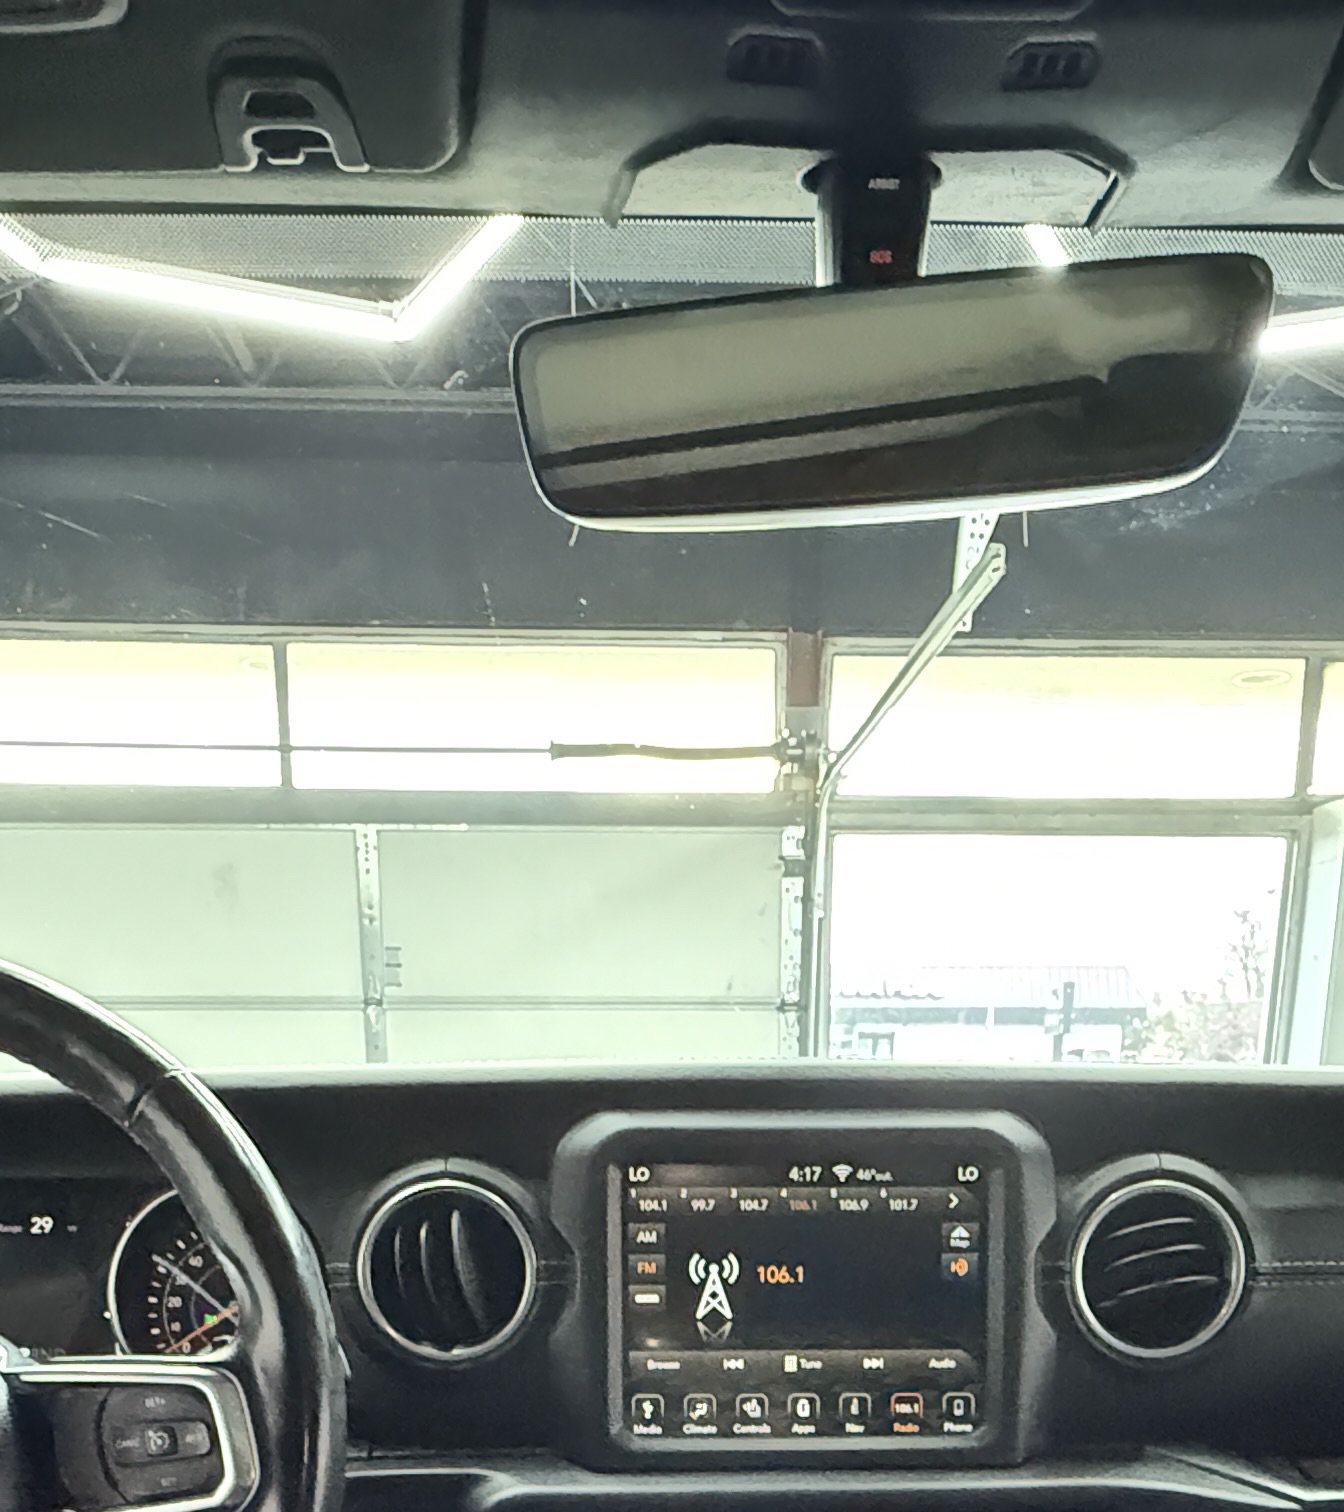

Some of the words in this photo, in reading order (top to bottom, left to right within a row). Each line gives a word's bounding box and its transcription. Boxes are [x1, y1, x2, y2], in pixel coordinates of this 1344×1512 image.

[869, 250, 893, 264] SOS
[628, 1166, 651, 1182] LO
[789, 1165, 822, 1182] 4:17
[957, 1166, 979, 1182] LO
[638, 1199, 668, 1211] 104.1
[691, 1199, 716, 1211] 99.7
[739, 1199, 769, 1211] 104.7
[889, 1199, 919, 1211] 101.7
[29, 1216, 54, 1234] 29
[636, 1230, 657, 1243] AM
[637, 1261, 656, 1274] FM
[757, 1265, 804, 1284] 106.1
[167, 1296, 182, 1308] 20
